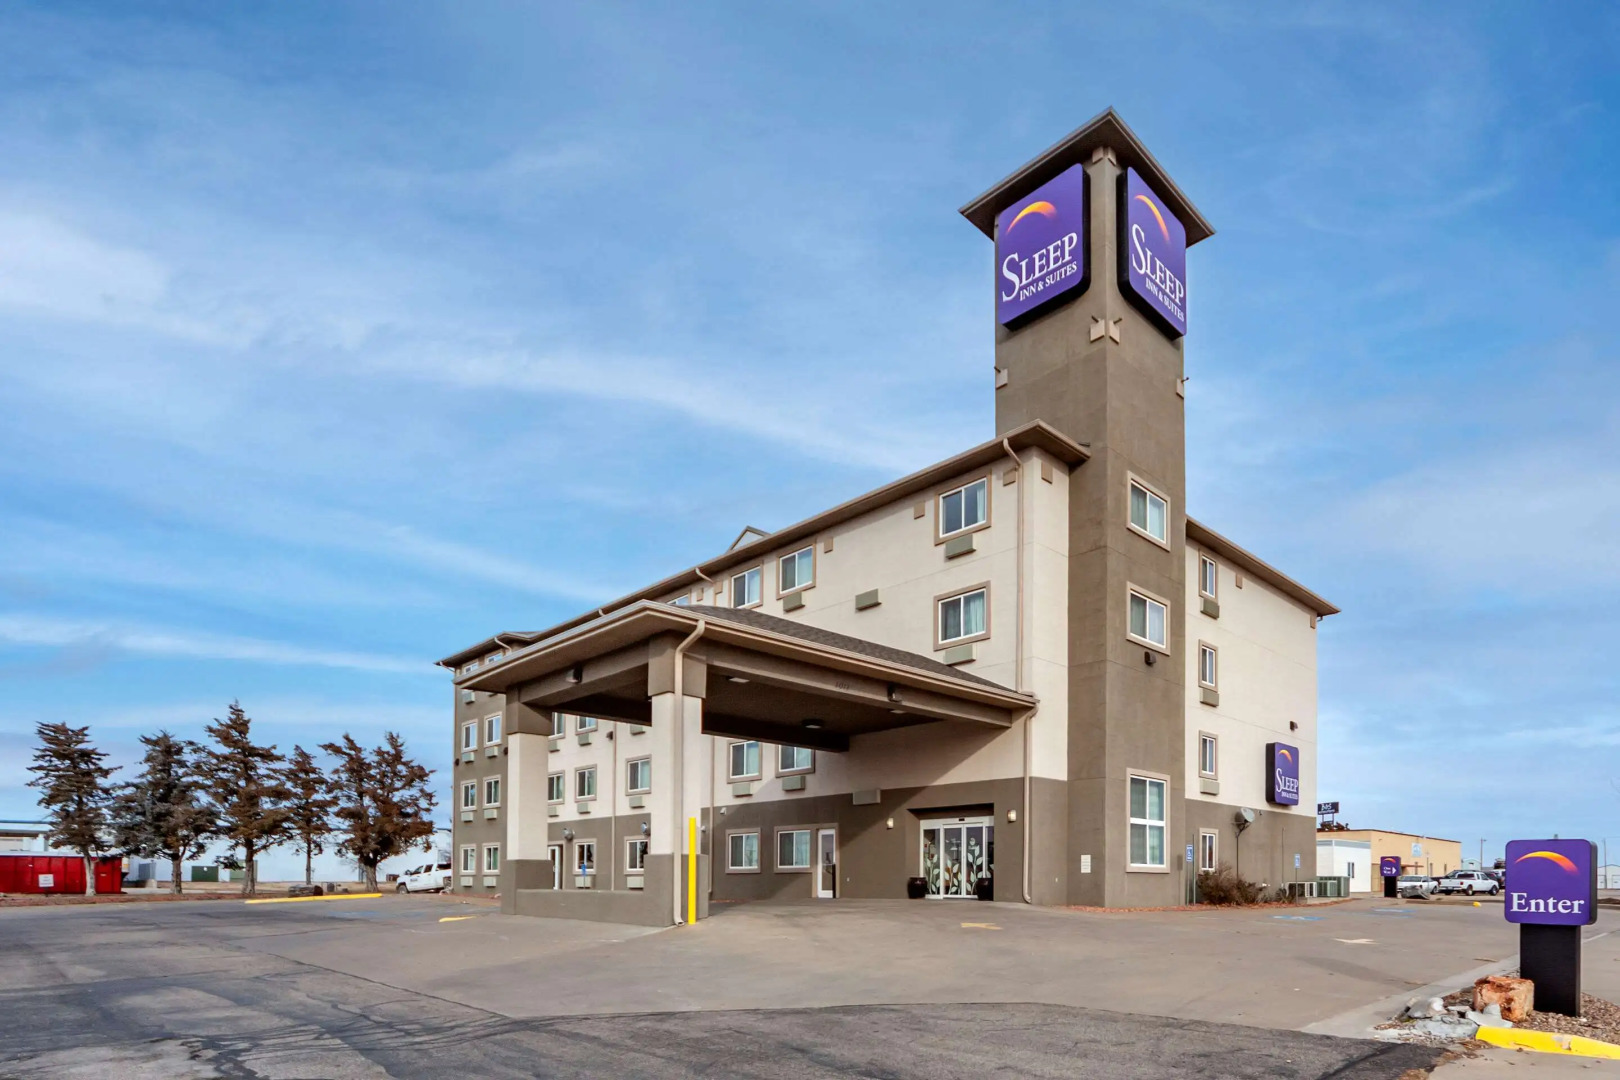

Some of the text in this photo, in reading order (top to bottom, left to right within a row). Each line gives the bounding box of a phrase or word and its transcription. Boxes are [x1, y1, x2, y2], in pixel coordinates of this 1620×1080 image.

[1002, 232, 1078, 302] SLEEP
[1019, 261, 1078, 302] INN & SUITES
[1132, 223, 1184, 306] SLEEP
[1145, 277, 1185, 322] INN & SUITES
[1276, 767, 1299, 793] SLEEP
[1510, 892, 1585, 914] Enter
